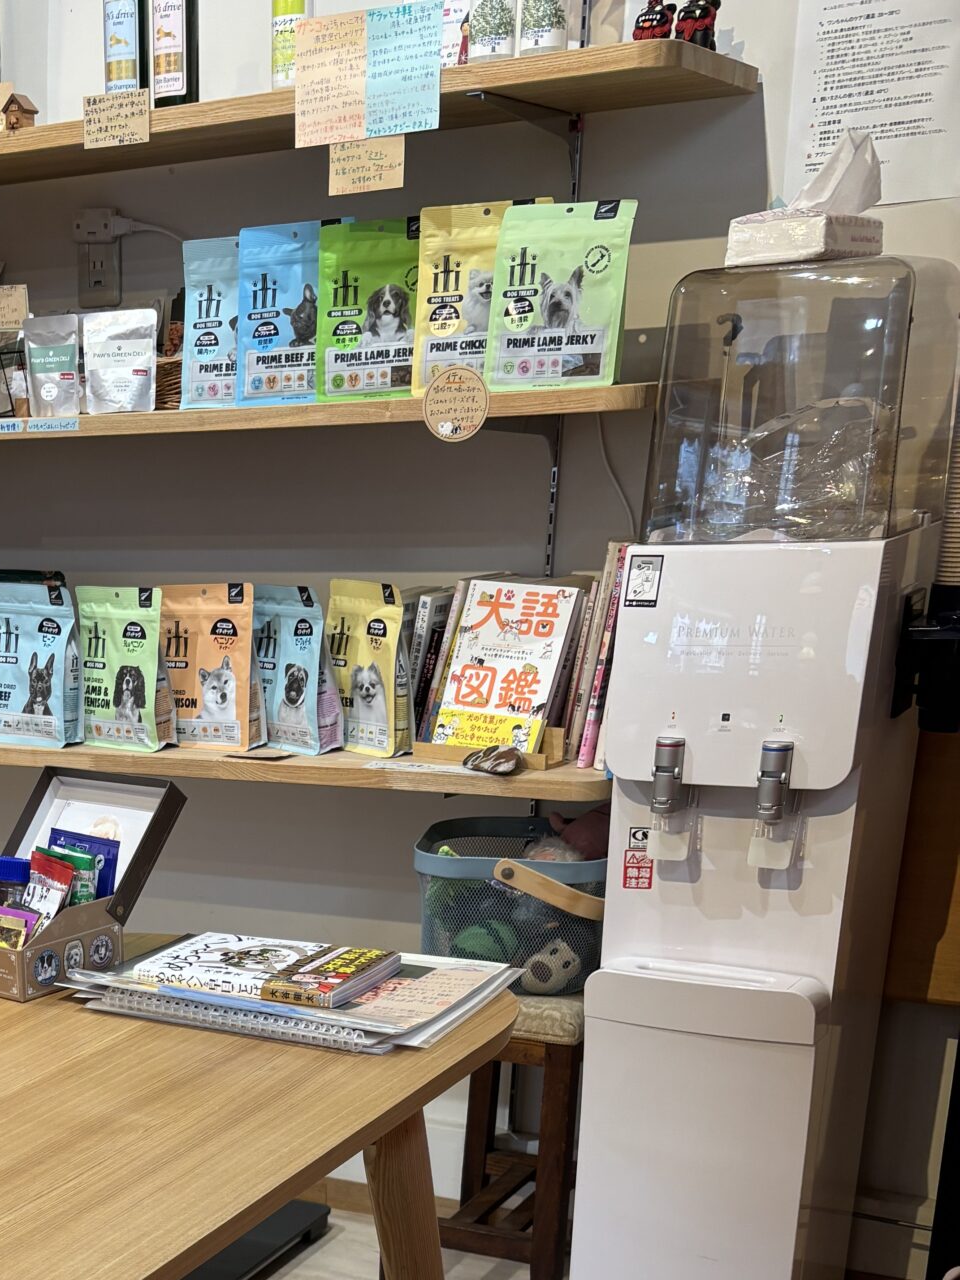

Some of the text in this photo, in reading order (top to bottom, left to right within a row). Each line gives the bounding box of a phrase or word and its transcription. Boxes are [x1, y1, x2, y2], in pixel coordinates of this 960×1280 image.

[163, 2, 181, 12] drive
[116, 10, 134, 19] drive
[114, 83, 135, 91] Shampoo
[519, 289, 535, 297] TREATS
[262, 311, 277, 319] TREATS
[506, 334, 597, 349] PRIME LAMB JERKY
[430, 343, 458, 353] PRIME
[44, 356, 58, 364] GREEN
[58, 354, 71, 362] DELI
[256, 355, 282, 365] PRIME
[285, 353, 304, 363] BEEF
[335, 353, 363, 364] PRIME
[365, 350, 390, 361] LAMB
[199, 363, 222, 373] PRIME
[472, 588, 560, 638] 犬語
[677, 625, 796, 640] PREMIUM WATER
[213, 636, 236, 647] ベニソン
[369, 637, 384, 646] チキン
[84, 685, 109, 696] AMB &
[454, 664, 540, 714] 図鑑
[466, 713, 507, 725] 犬の「言葉」が
[469, 724, 499, 734] 分かれば
[627, 878, 651, 889] 注意
